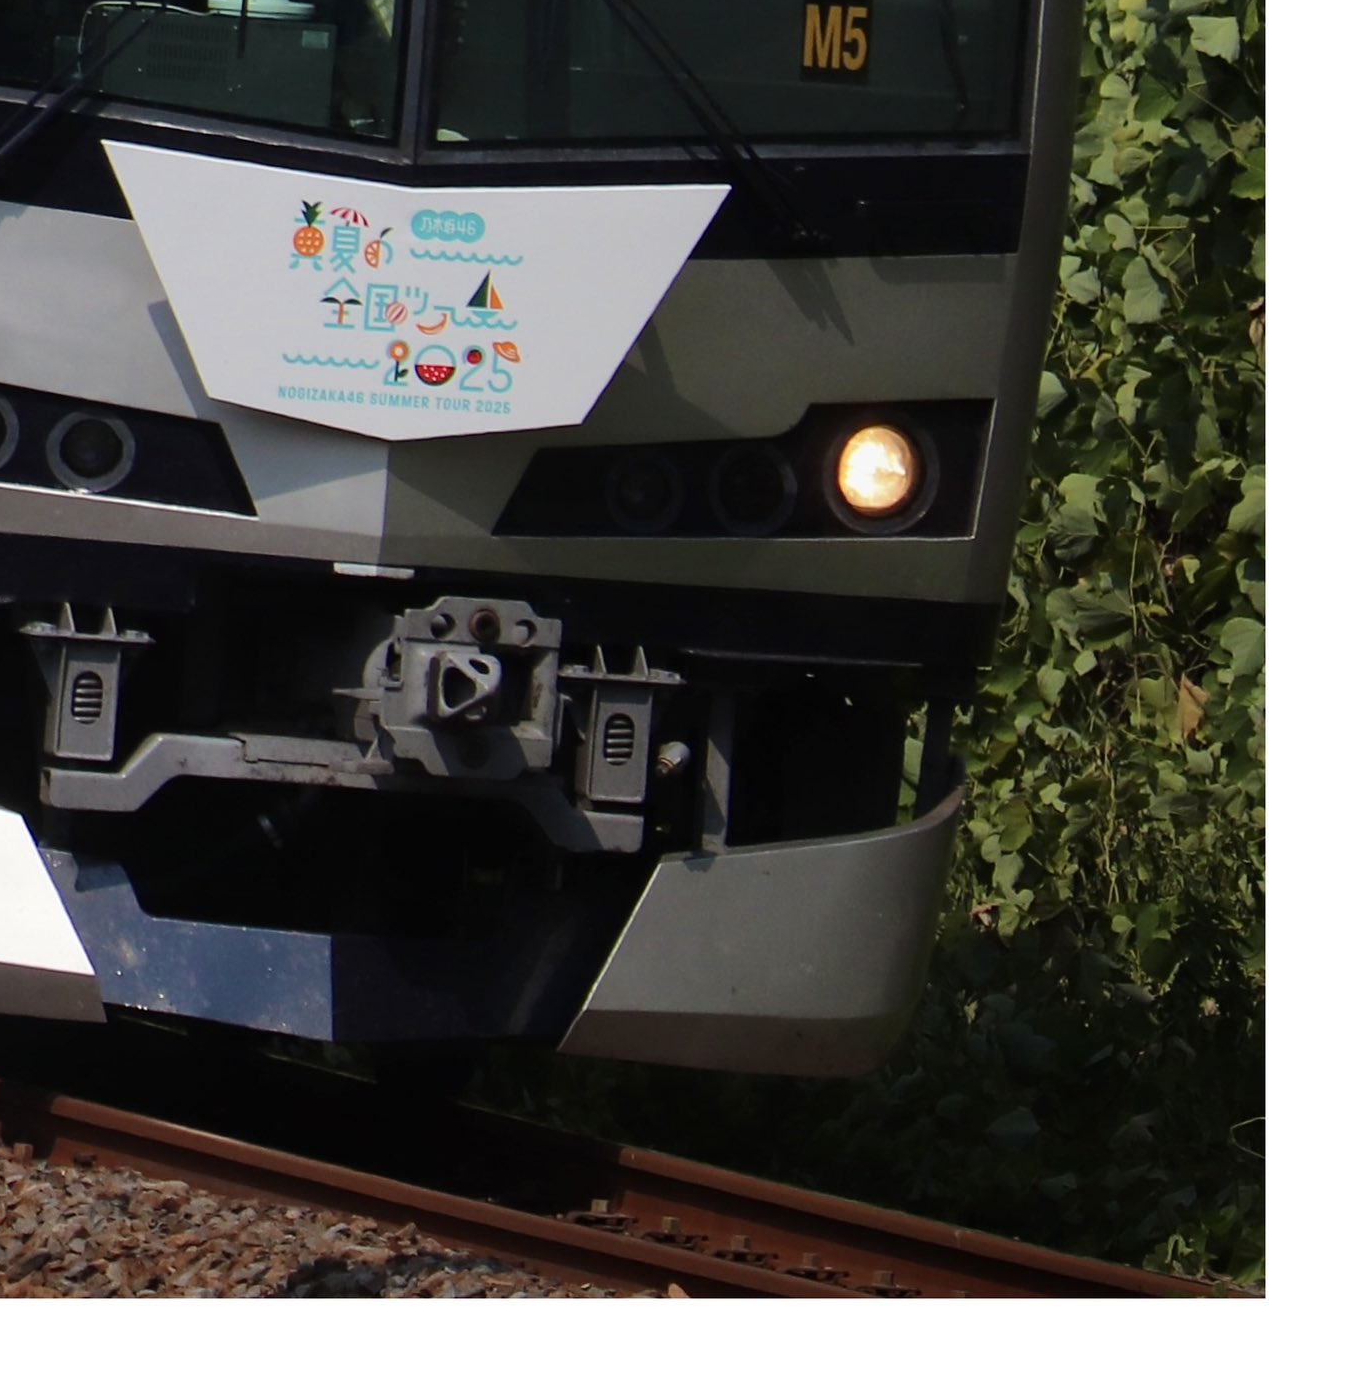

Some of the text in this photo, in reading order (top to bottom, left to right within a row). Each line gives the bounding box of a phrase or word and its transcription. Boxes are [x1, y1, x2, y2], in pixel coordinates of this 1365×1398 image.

[803, 3, 868, 71] M5
[277, 385, 512, 415] NOGIZAKA46 SUMMER TOUR 2025
